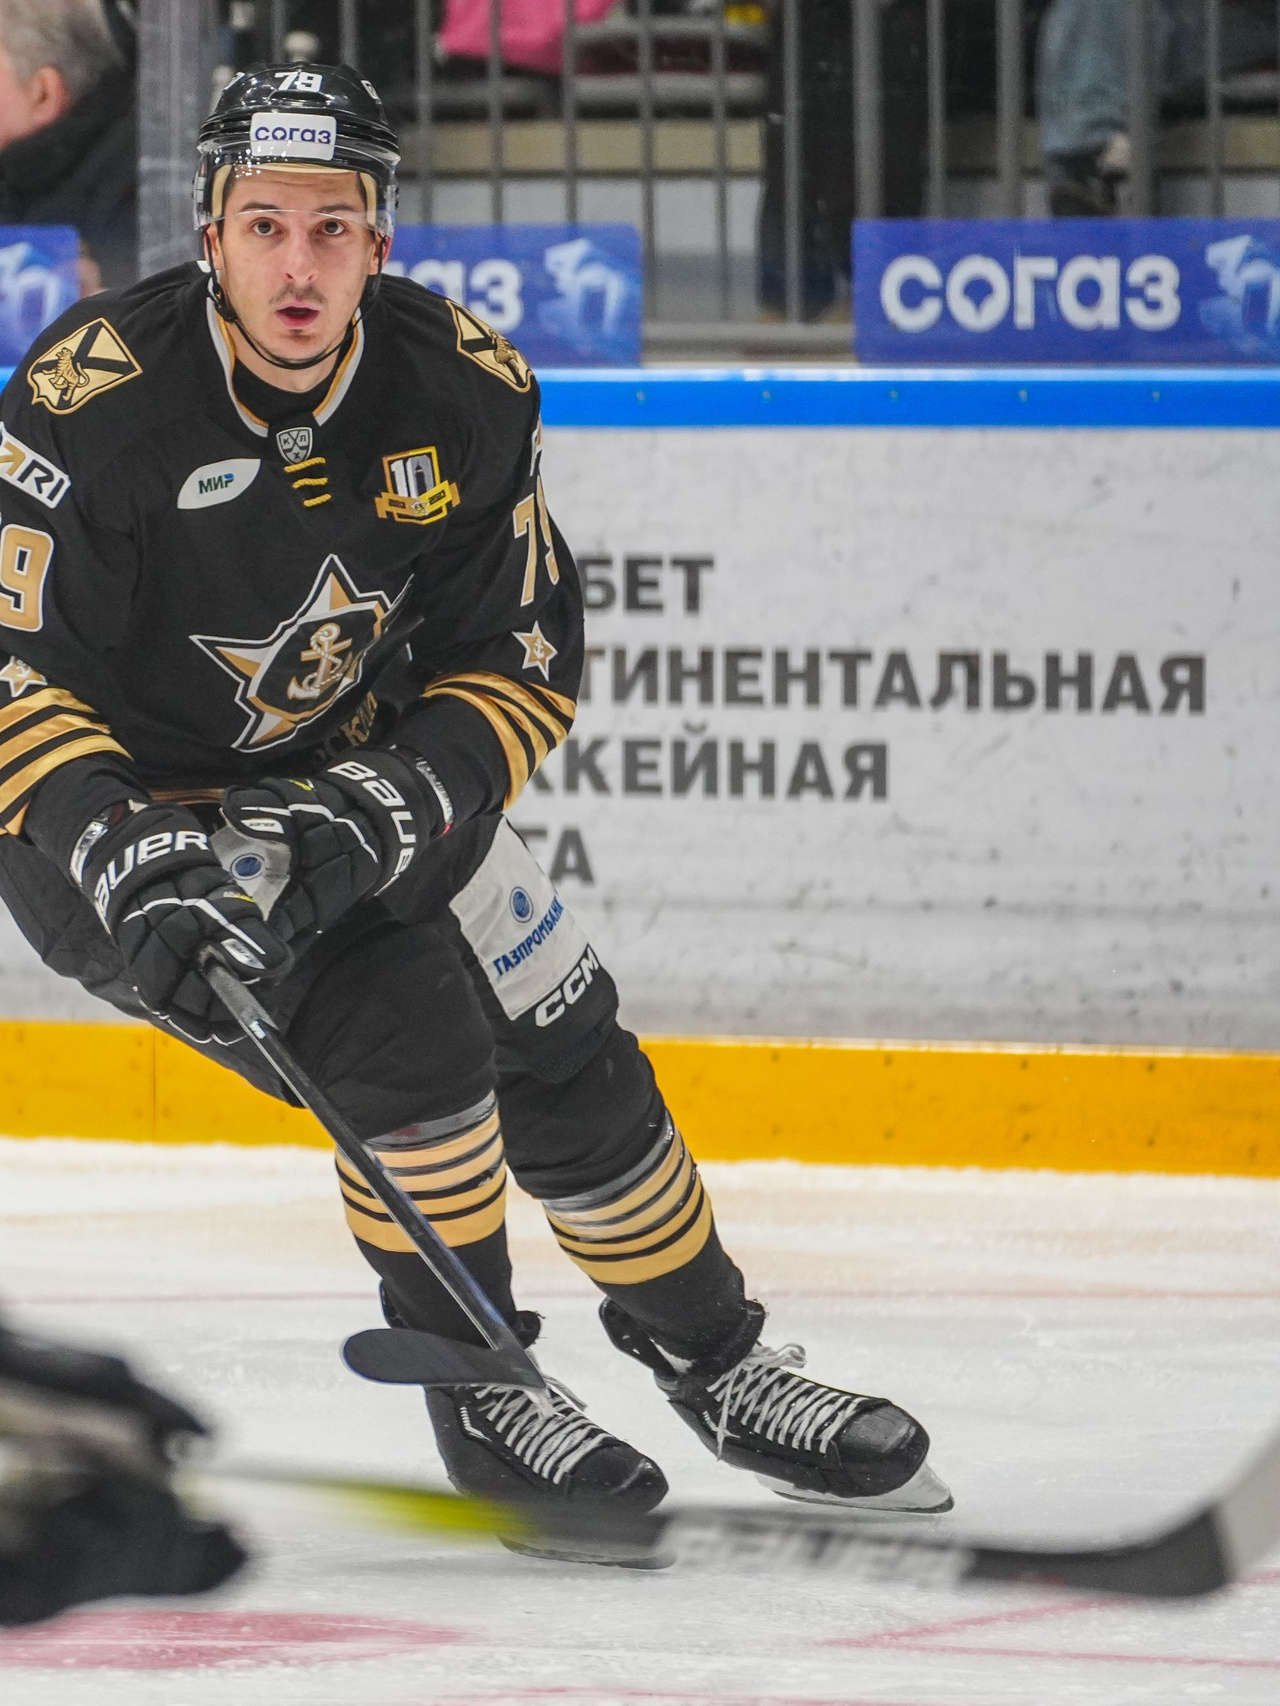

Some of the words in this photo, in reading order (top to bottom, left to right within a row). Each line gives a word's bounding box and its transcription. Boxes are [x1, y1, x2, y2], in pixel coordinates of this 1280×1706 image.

[275, 71, 322, 93] 79
[531, 719, 889, 800] КЕЙНАЯ
[535, 953, 600, 1028] CCM
